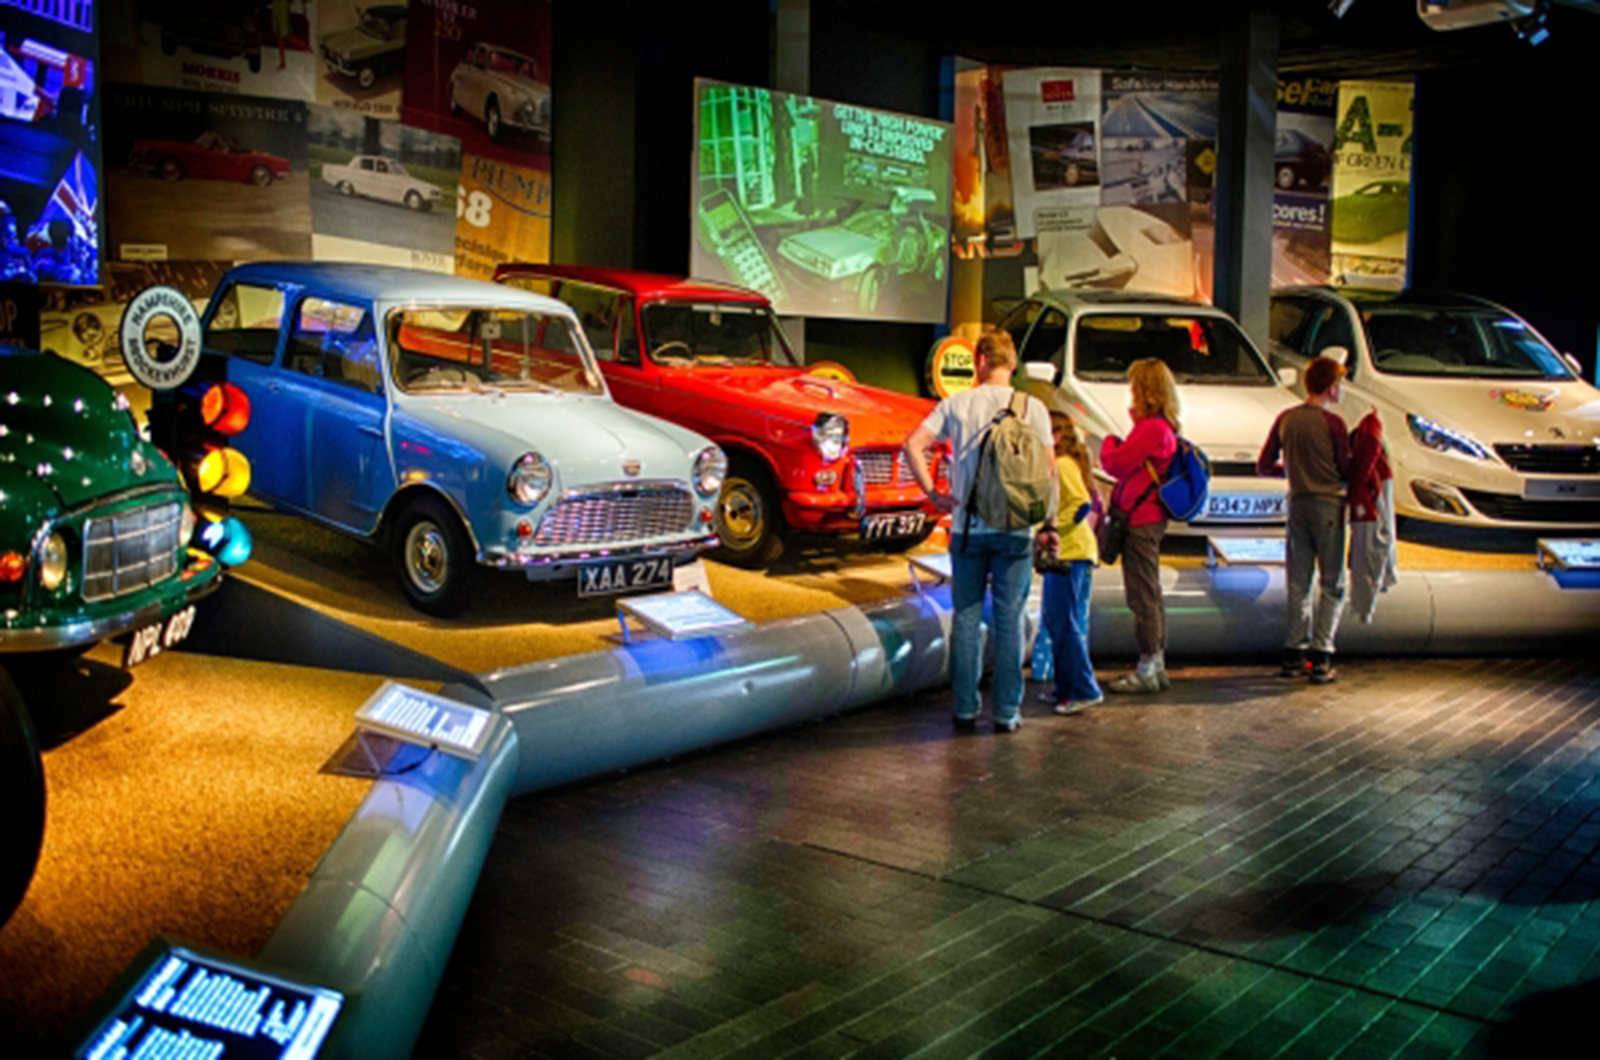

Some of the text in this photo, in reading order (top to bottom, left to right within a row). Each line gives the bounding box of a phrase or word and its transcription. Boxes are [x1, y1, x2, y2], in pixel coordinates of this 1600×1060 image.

[182, 61, 241, 83] MORRIS
[208, 102, 289, 122] SPITFIRE
[1347, 153, 1396, 170] GREEN
[131, 293, 194, 327] HAMPSHIRE
[128, 338, 197, 382] BROCKENHURST
[943, 352, 973, 367] STOP
[585, 559, 670, 592] XAA 274
